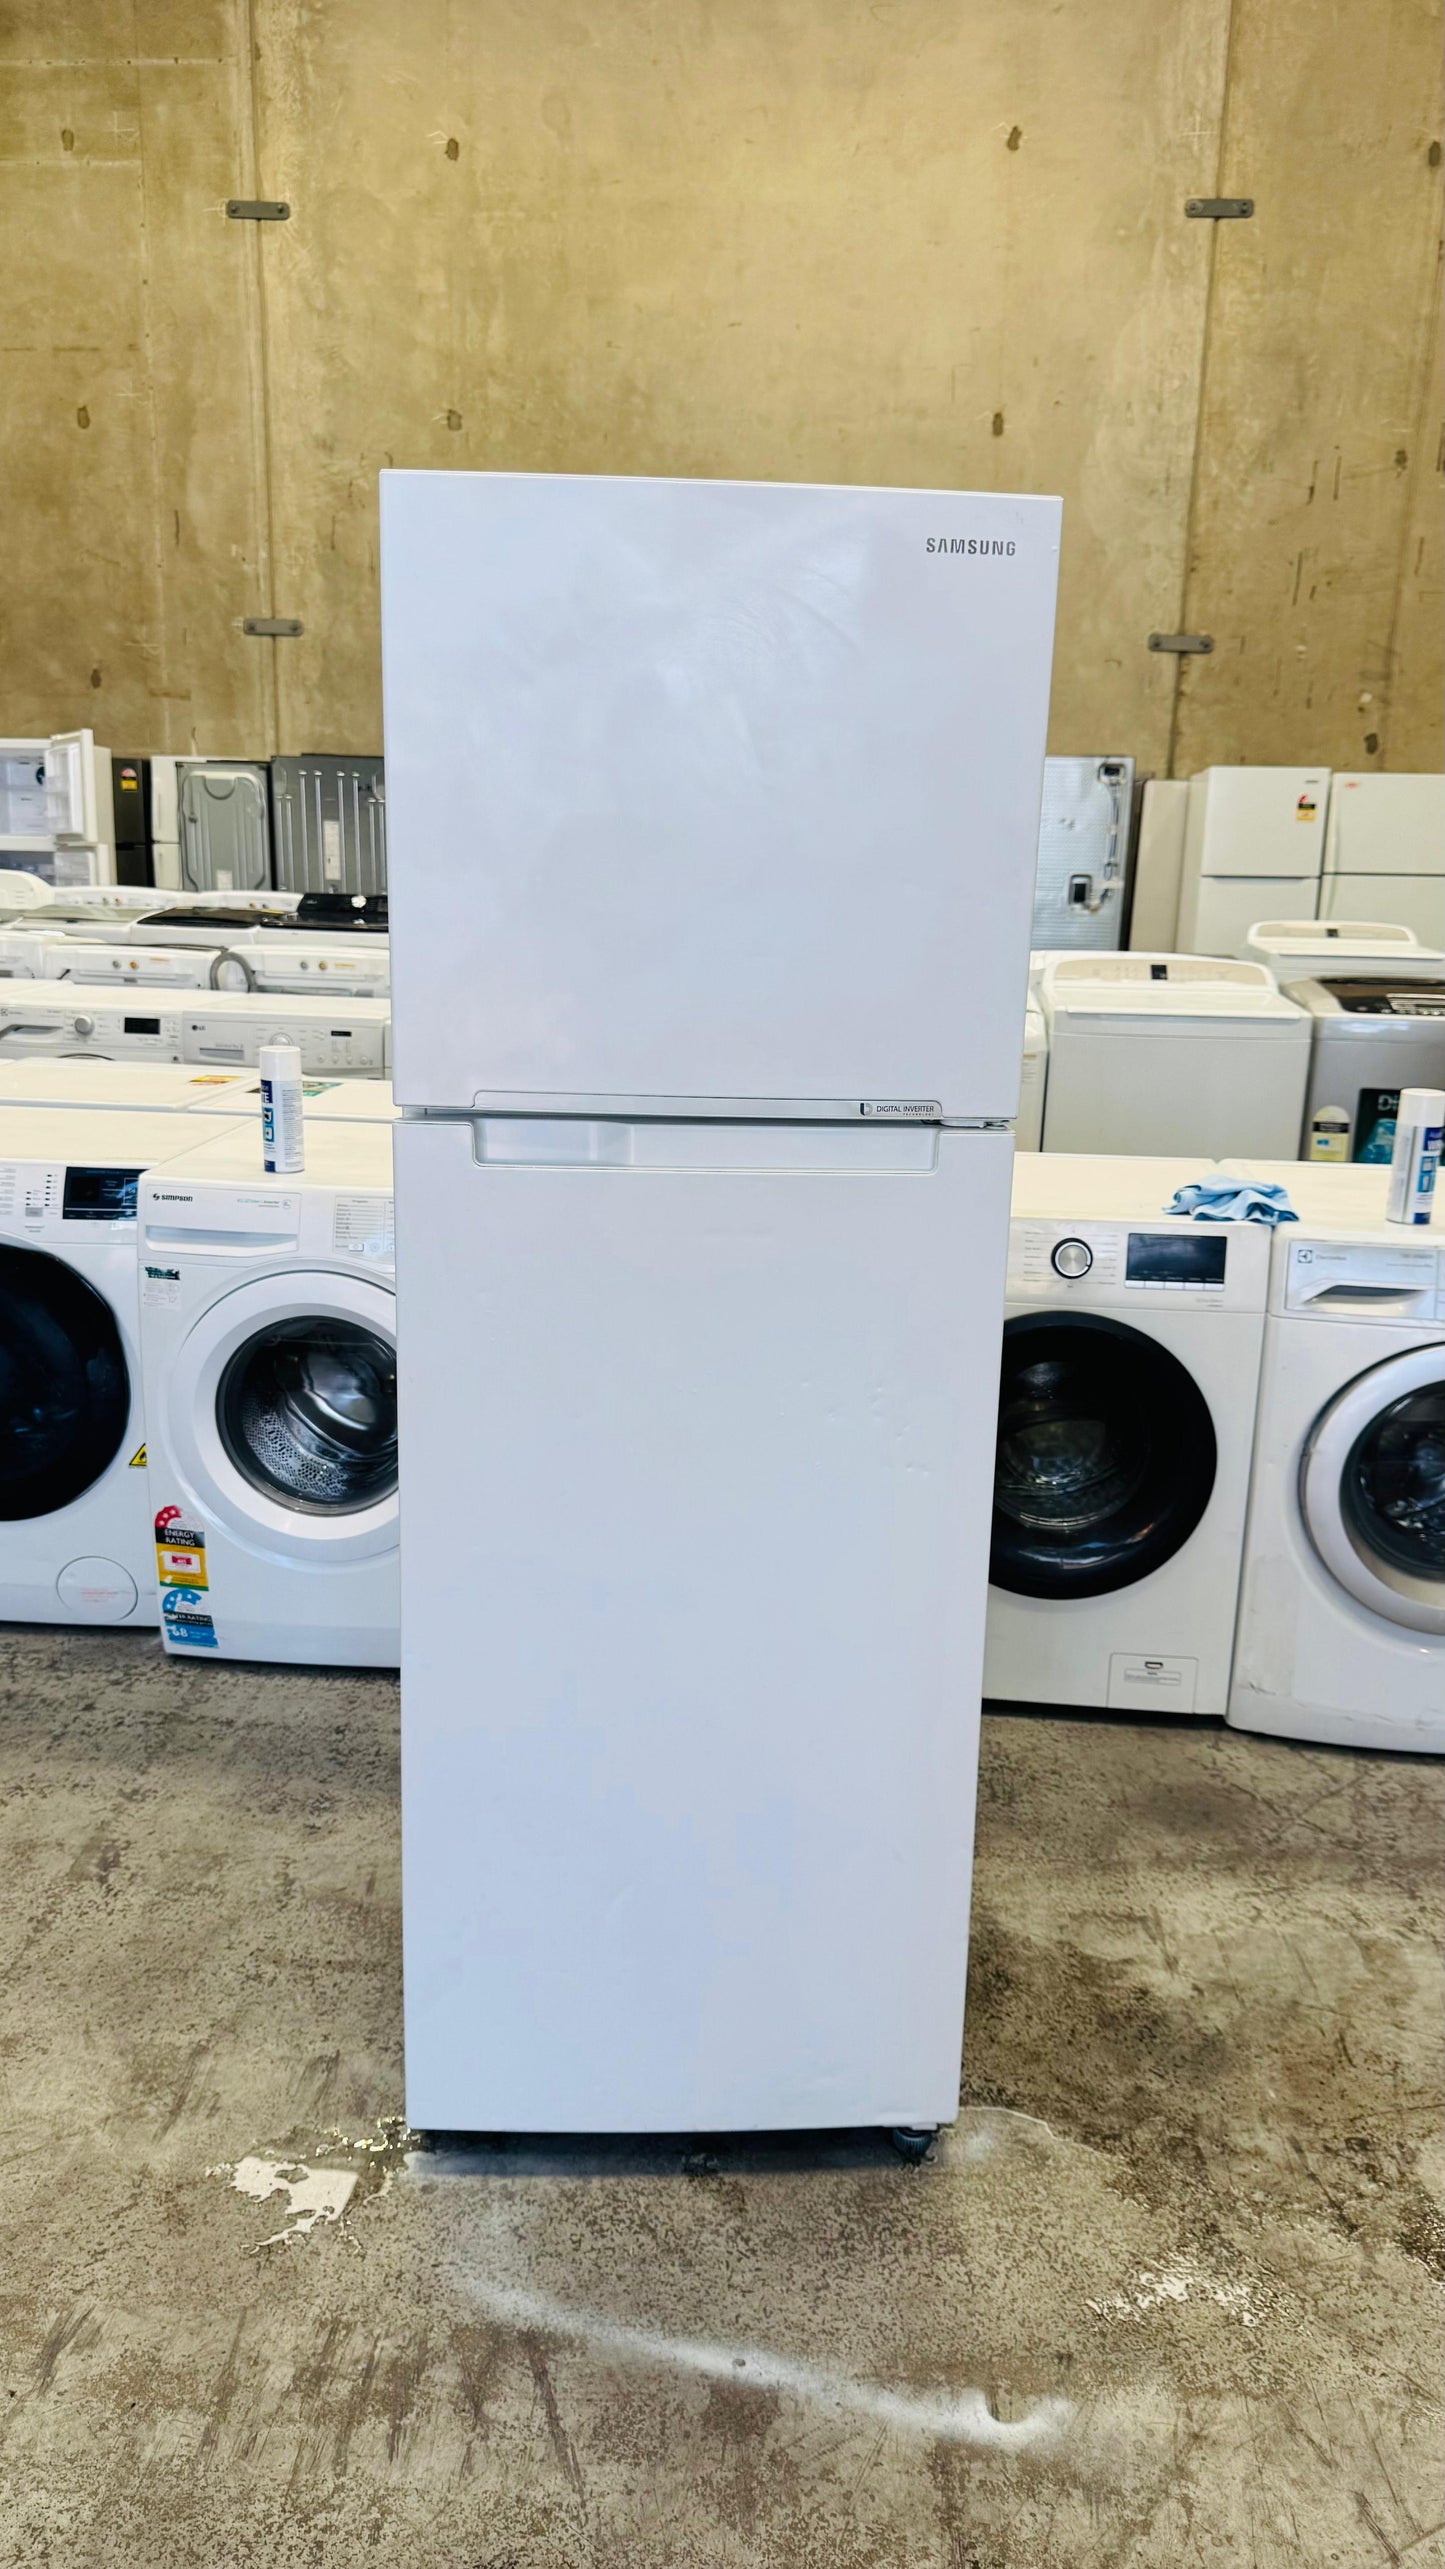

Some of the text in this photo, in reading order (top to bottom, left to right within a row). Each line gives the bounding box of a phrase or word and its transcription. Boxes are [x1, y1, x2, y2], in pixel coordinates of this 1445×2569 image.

[926, 537, 1016, 556] SAMSUNG
[902, 1105, 934, 1113] INVERTER
[161, 1194, 193, 1202] SIMPSON
[164, 1529, 195, 1539] ENERGY
[165, 1536, 195, 1546] RATING
